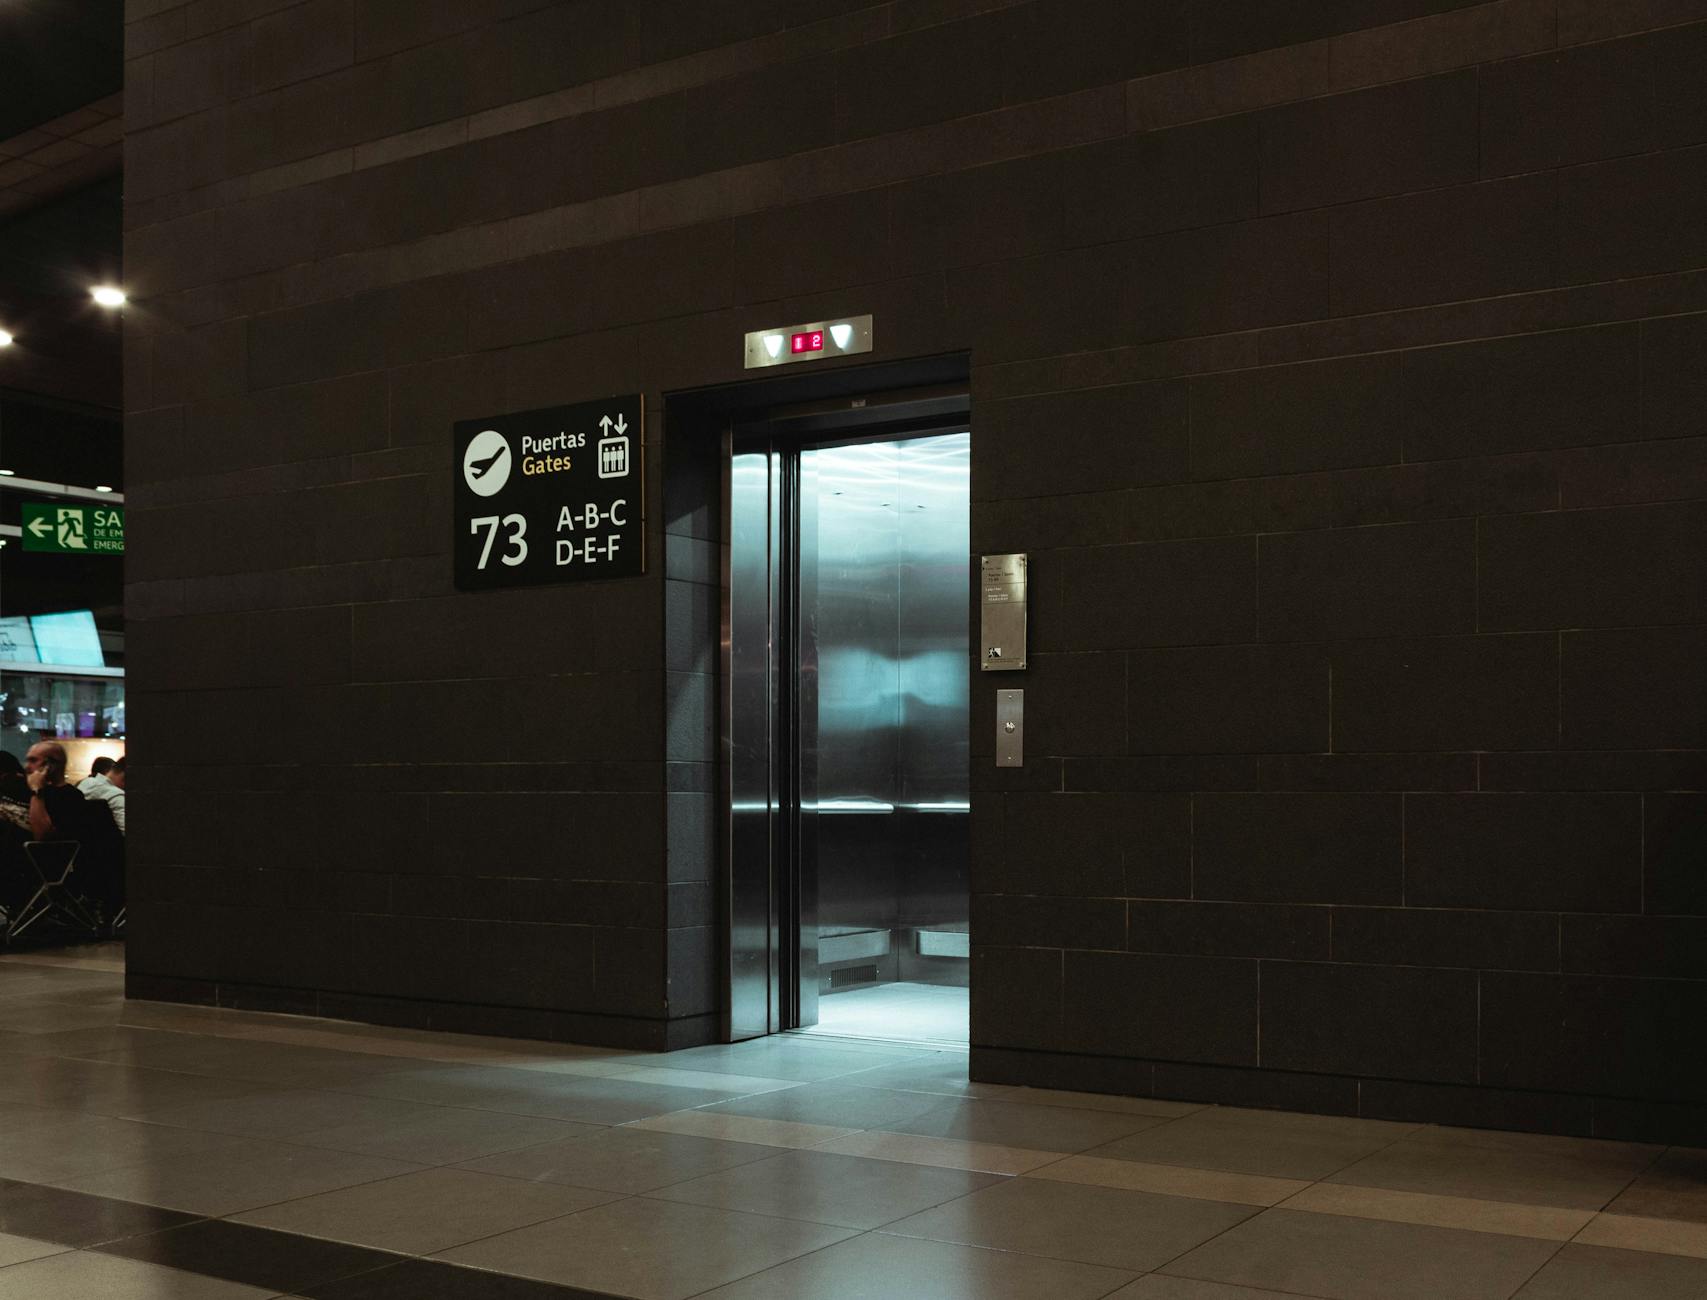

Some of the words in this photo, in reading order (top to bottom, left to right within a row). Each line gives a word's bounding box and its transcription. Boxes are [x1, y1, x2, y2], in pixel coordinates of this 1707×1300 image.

[521, 431, 586, 455] Puertas
[522, 454, 572, 476] Gates
[94, 510, 124, 527] SA
[556, 499, 627, 532] A-B-C
[94, 529, 106, 537] DE
[470, 513, 529, 570] 73
[555, 534, 621, 566] D-E-F
